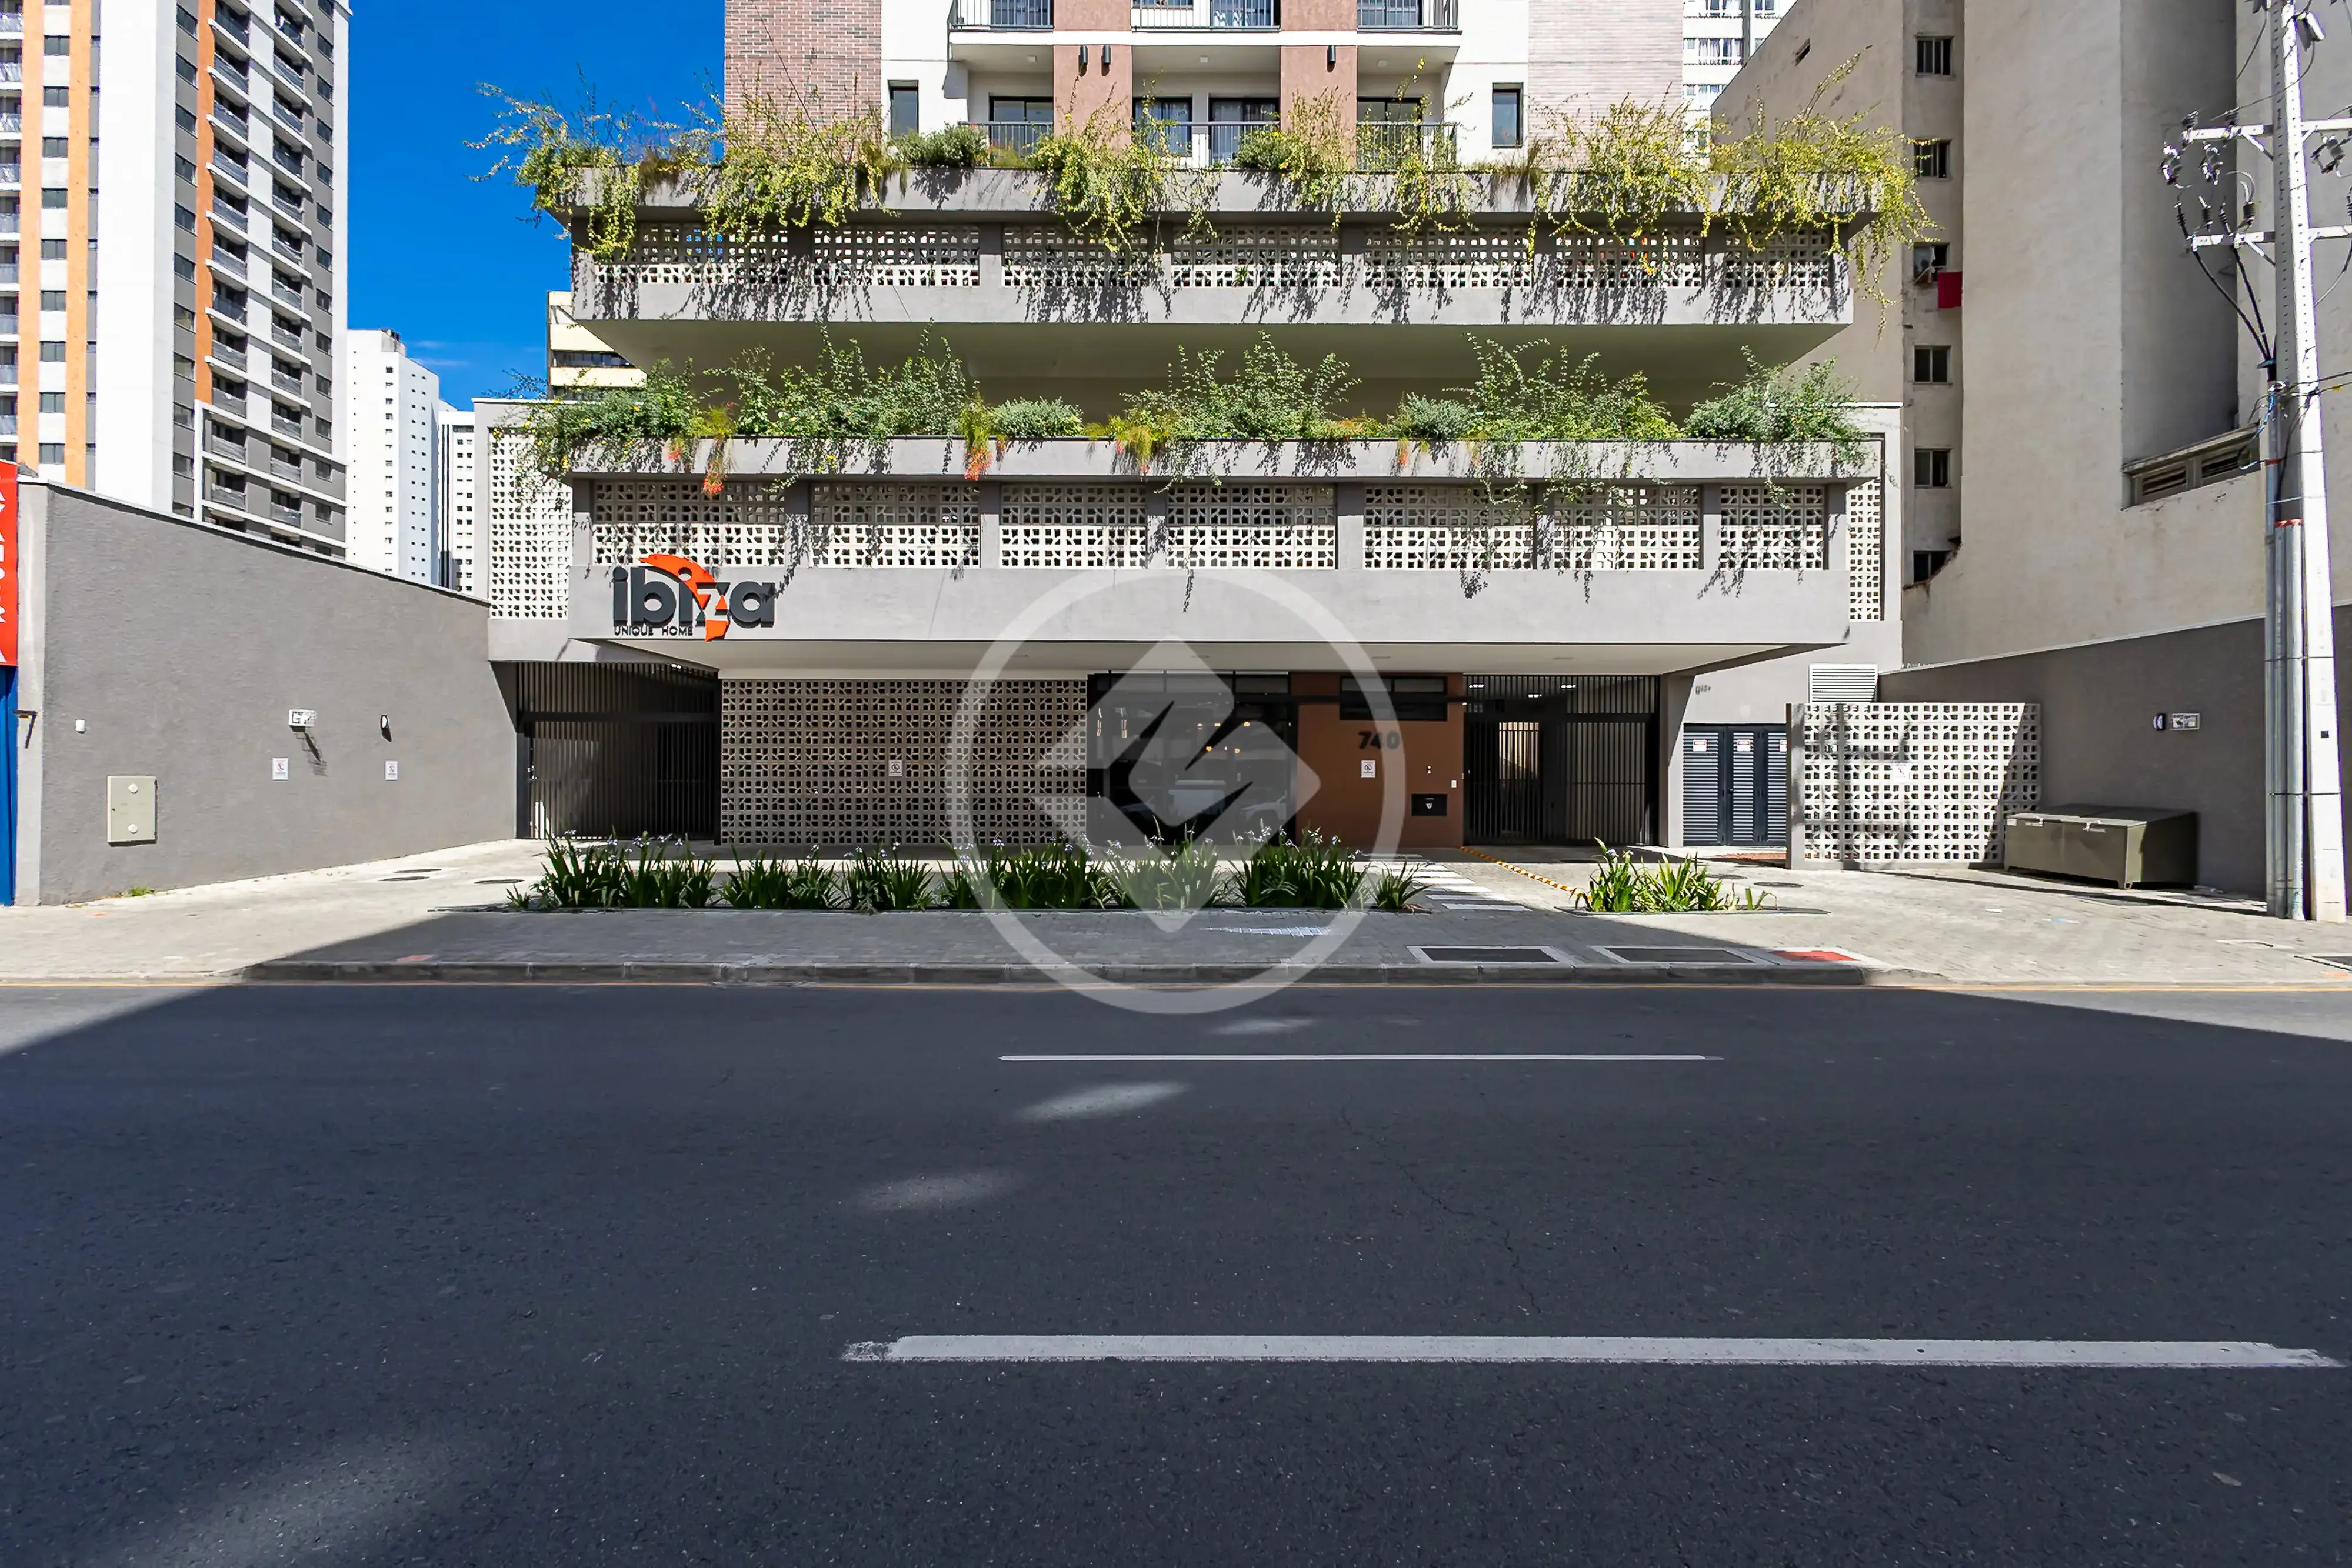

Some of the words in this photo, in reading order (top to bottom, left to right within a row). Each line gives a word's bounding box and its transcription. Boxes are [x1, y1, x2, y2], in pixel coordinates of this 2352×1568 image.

[613, 566, 775, 628] ibiza
[614, 625, 654, 636] UNIQUE
[662, 625, 694, 636] HOME
[1358, 731, 1401, 750] 740
